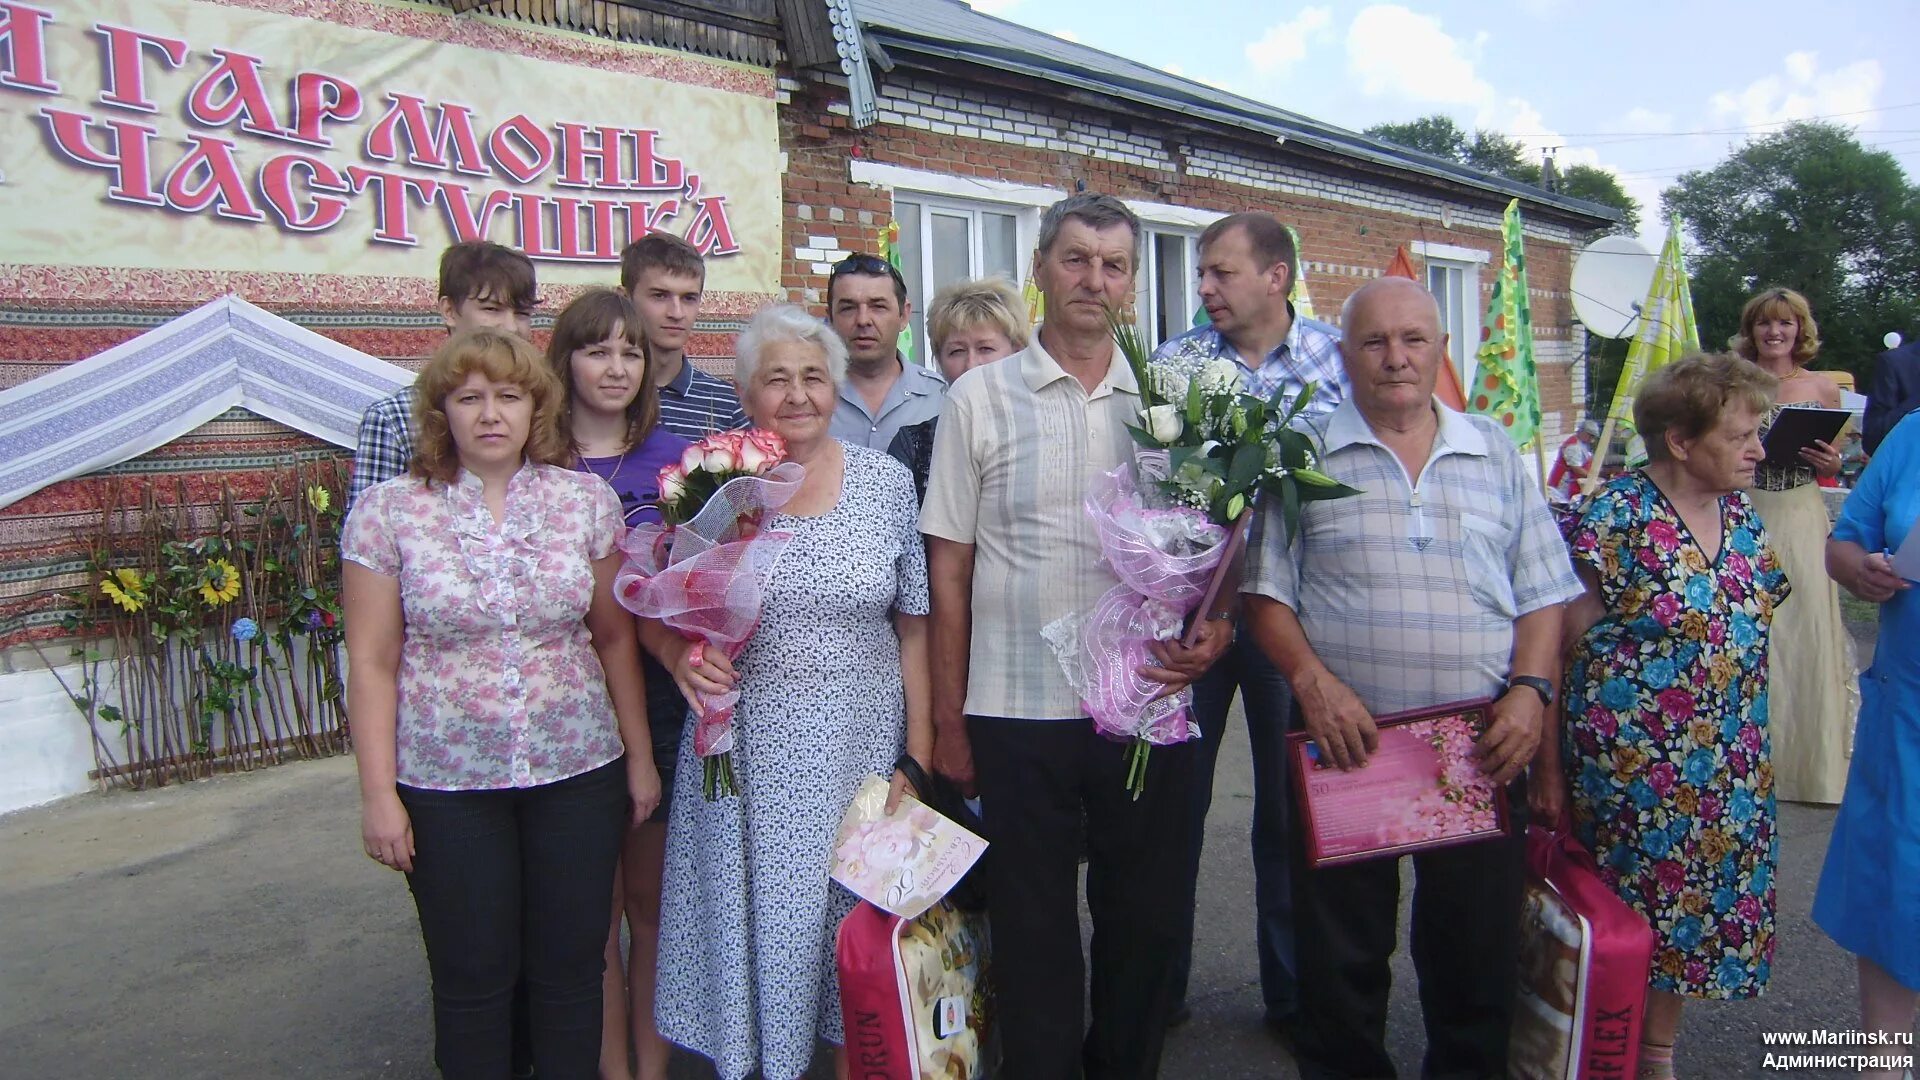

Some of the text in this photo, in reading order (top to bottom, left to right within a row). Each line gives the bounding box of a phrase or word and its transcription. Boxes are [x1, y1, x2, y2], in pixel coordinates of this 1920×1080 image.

[39, 107, 741, 262] ЧАСТУШКА
[94, 23, 702, 199] ГАРМОНЬ,
[1589, 1004, 1634, 1080] FLEX
